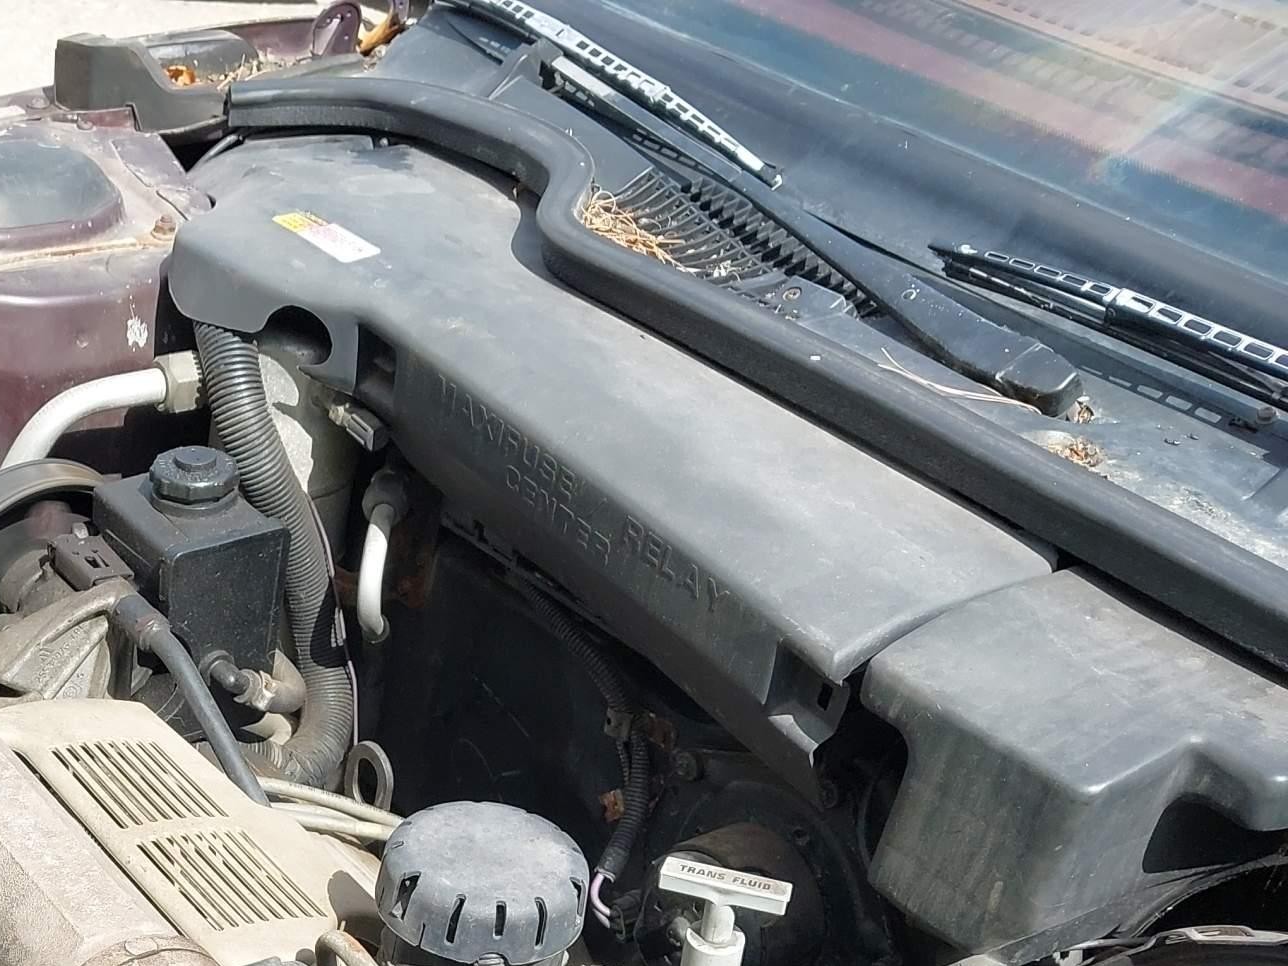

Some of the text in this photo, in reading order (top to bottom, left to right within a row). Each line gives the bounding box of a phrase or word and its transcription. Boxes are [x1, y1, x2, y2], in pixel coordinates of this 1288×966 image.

[623, 513, 730, 613] RELAY
[679, 864, 772, 891] TRANS FLUID
